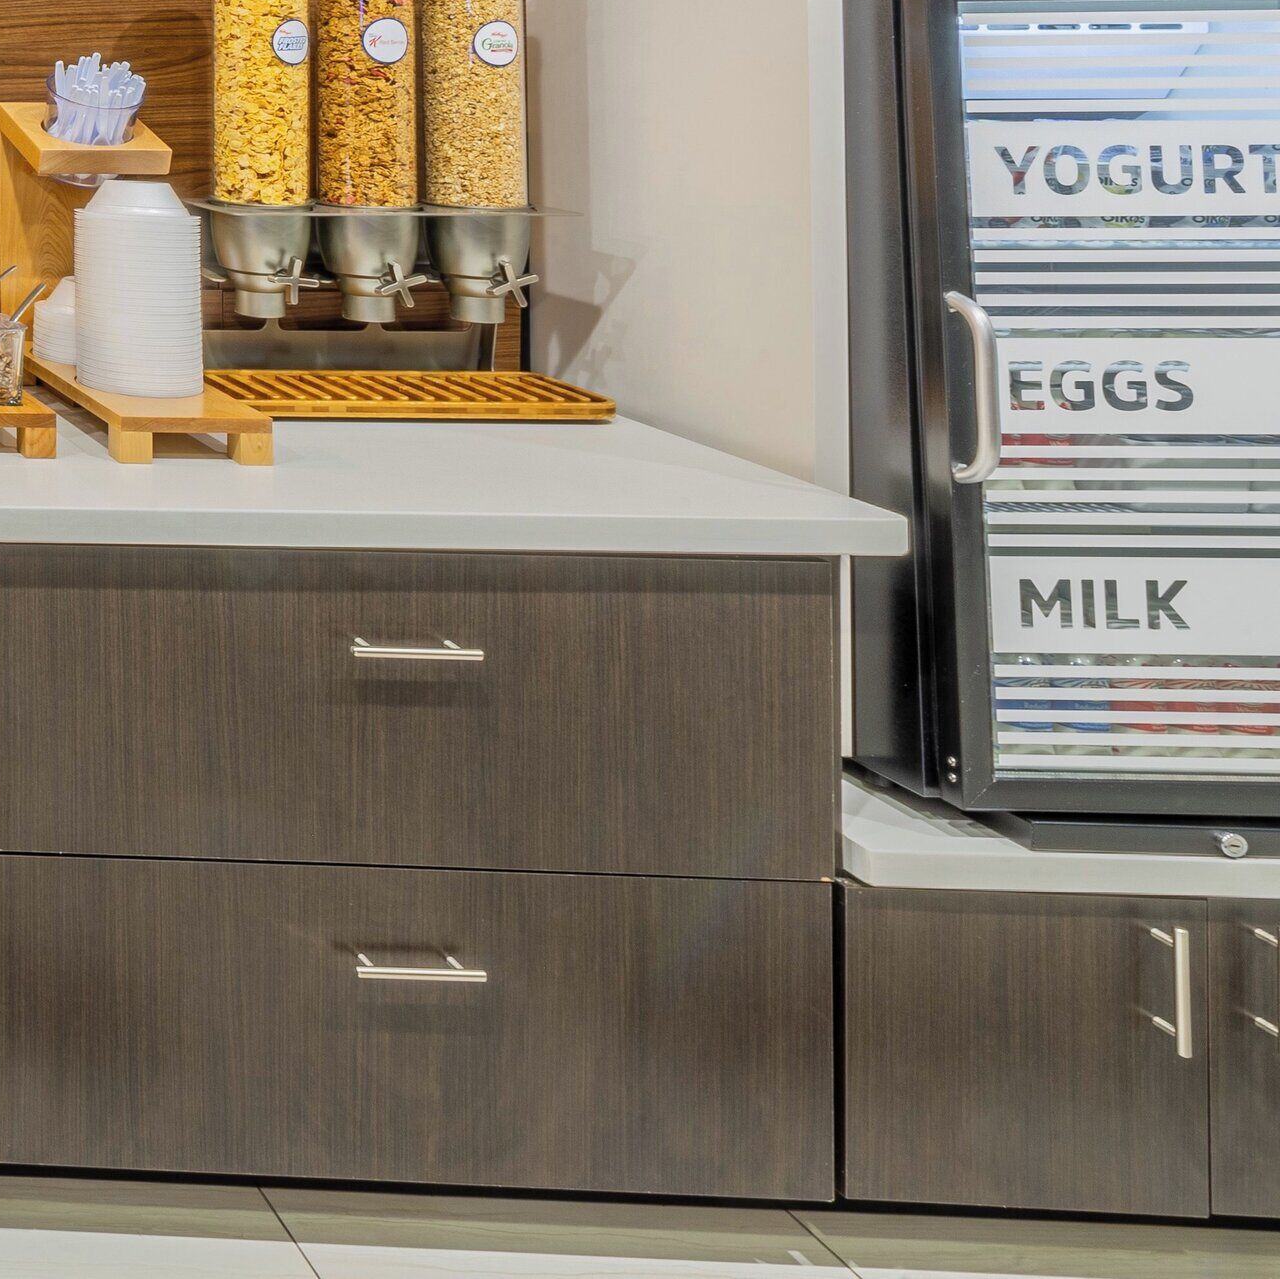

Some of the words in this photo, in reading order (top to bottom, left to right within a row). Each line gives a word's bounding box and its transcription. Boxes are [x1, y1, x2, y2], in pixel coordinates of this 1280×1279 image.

[994, 144, 1280, 196] YOGURT
[1007, 359, 1194, 412] EGGS
[1019, 579, 1191, 630] MILK
